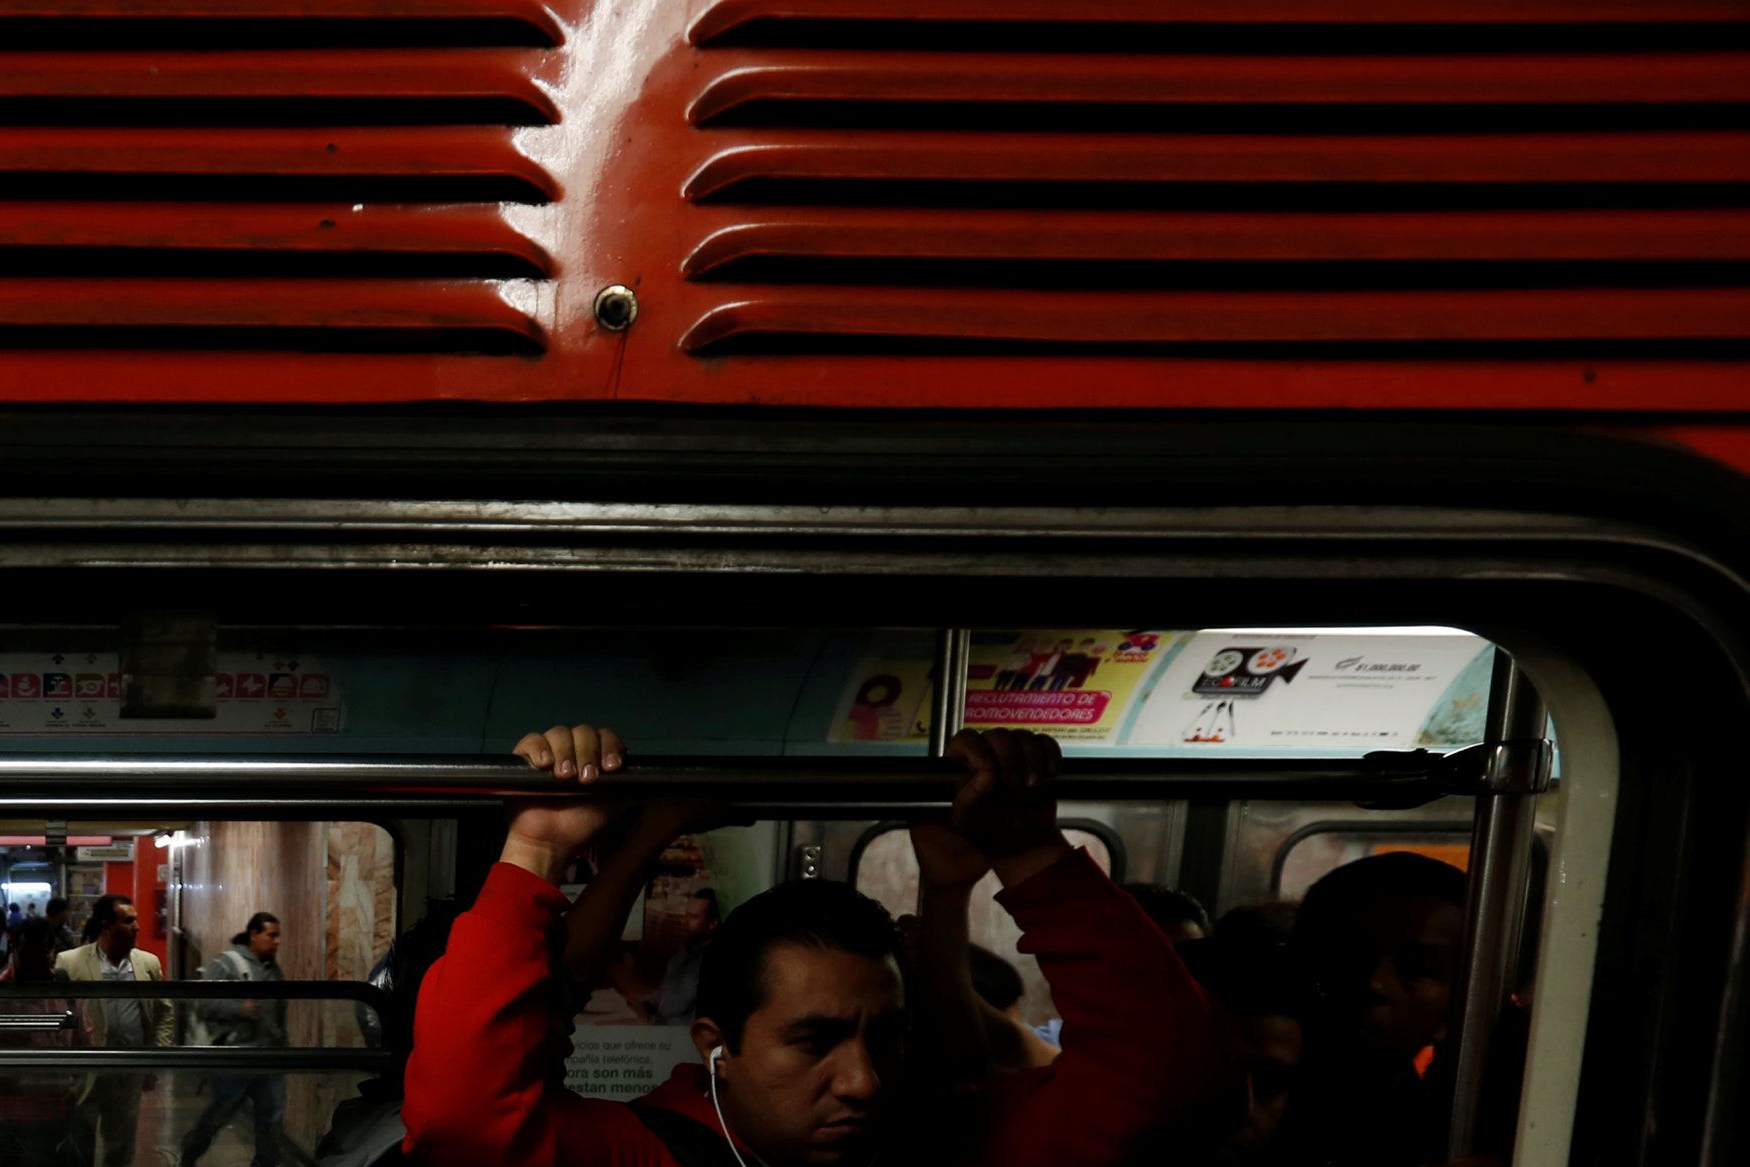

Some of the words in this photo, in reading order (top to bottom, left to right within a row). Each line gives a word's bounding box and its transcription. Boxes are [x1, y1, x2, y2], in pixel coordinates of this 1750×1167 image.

[1078, 692, 1098, 704] DE
[965, 707, 1094, 720] ROMOVENDEDORES
[602, 1042, 621, 1052] que
[625, 1040, 656, 1050] ofrece
[658, 1042, 670, 1050] su
[566, 1069, 588, 1078] ora
[593, 1069, 619, 1079] son
[623, 1065, 653, 1078] más
